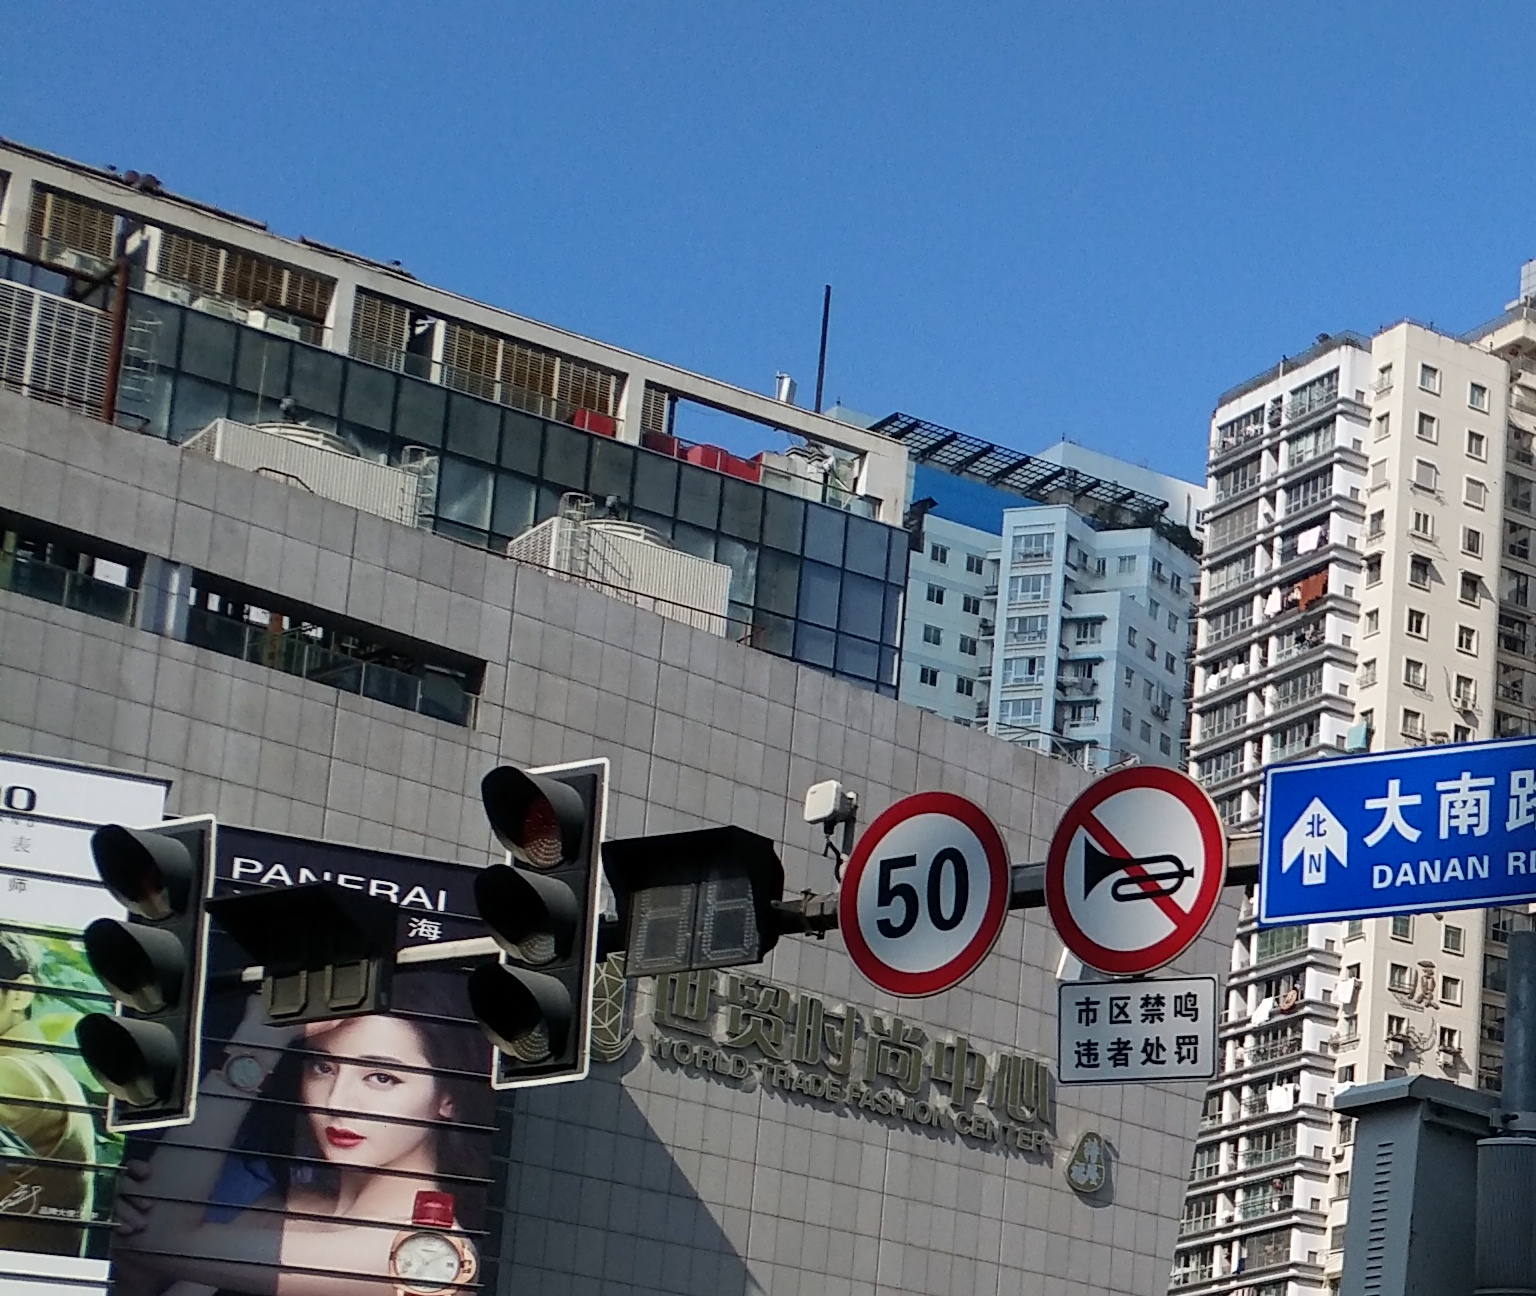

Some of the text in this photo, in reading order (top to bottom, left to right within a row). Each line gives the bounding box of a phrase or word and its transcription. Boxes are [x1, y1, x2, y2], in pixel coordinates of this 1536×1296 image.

[1304, 813, 1327, 838] 北
[1308, 853, 1321, 874] N
[1373, 854, 1490, 889] DANAN
[876, 847, 969, 938] 50
[1075, 992, 1199, 1027] 市区禁鸣
[1074, 1035, 1199, 1069] 违者处罚
[651, 1035, 1048, 1152] WORLD TRADE FASHION CENTER
